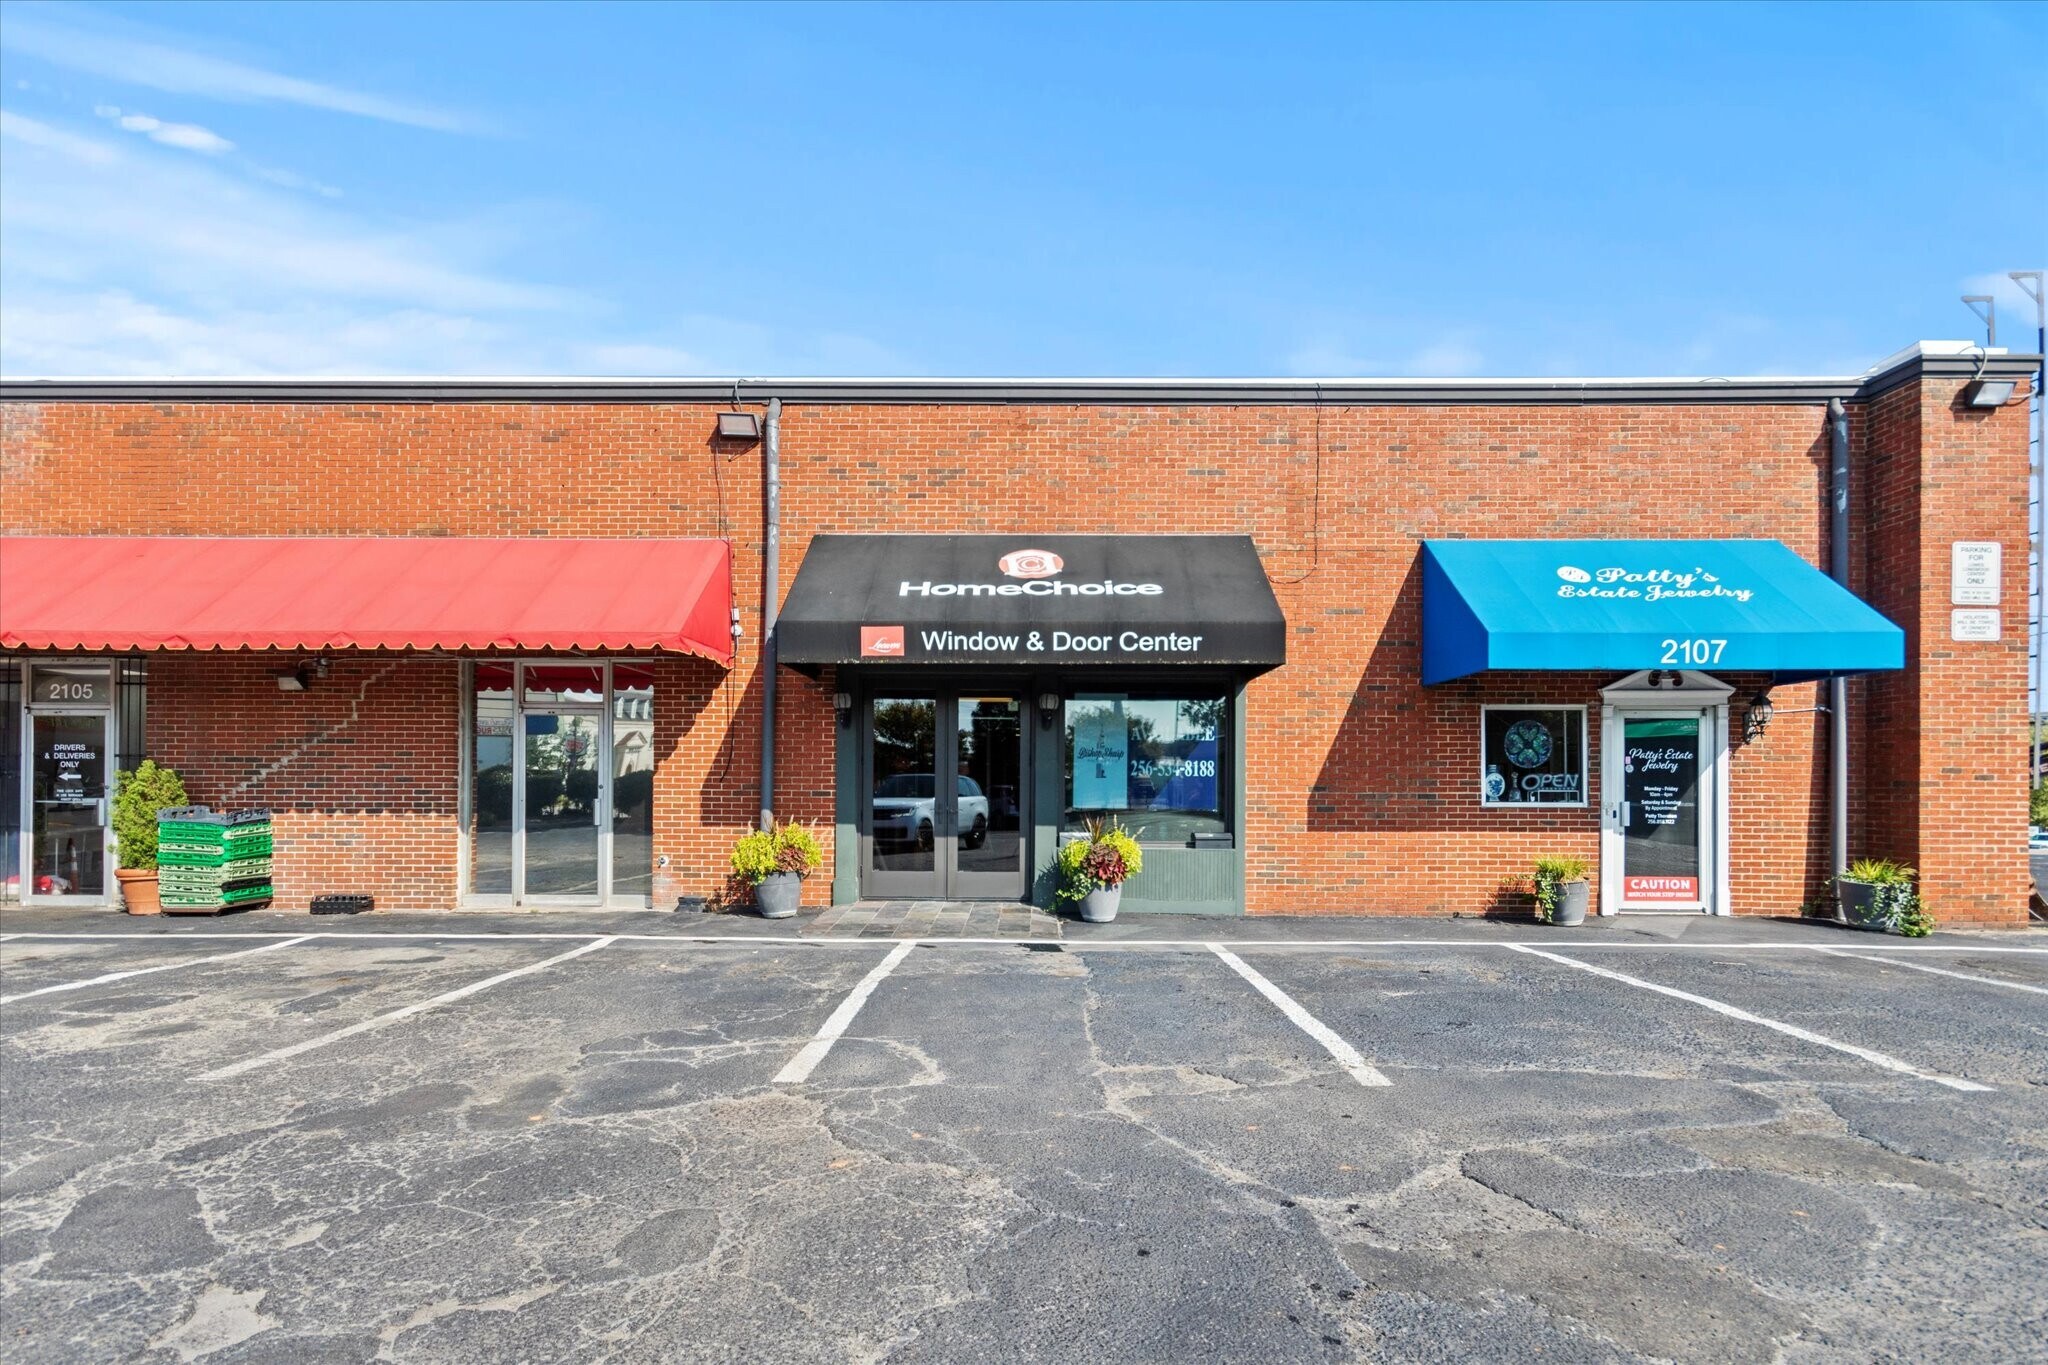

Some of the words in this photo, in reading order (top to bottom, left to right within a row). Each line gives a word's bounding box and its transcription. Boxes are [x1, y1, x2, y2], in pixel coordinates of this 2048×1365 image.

[1596, 567, 1719, 588] Patty's
[899, 580, 1164, 597] HomeChoice
[1557, 584, 1642, 598] Estate
[1645, 584, 1754, 601] Jewelry
[921, 631, 1019, 651] Window
[1026, 632, 1045, 651] &
[1053, 631, 1112, 651] Door
[1119, 631, 1203, 651] Center
[1660, 639, 1728, 664] 2107
[50, 683, 93, 699] 2105
[44, 752, 50, 760] &
[53, 752, 96, 760] DELIVERIES
[1629, 748, 1663, 762] Patty's
[1664, 748, 1694, 760] Estate
[1131, 760, 1215, 777] 256-534-8188
[1641, 760, 1679, 774] Jewelry
[1521, 774, 1579, 790] OPEN
[1630, 879, 1690, 889] CAUTION
